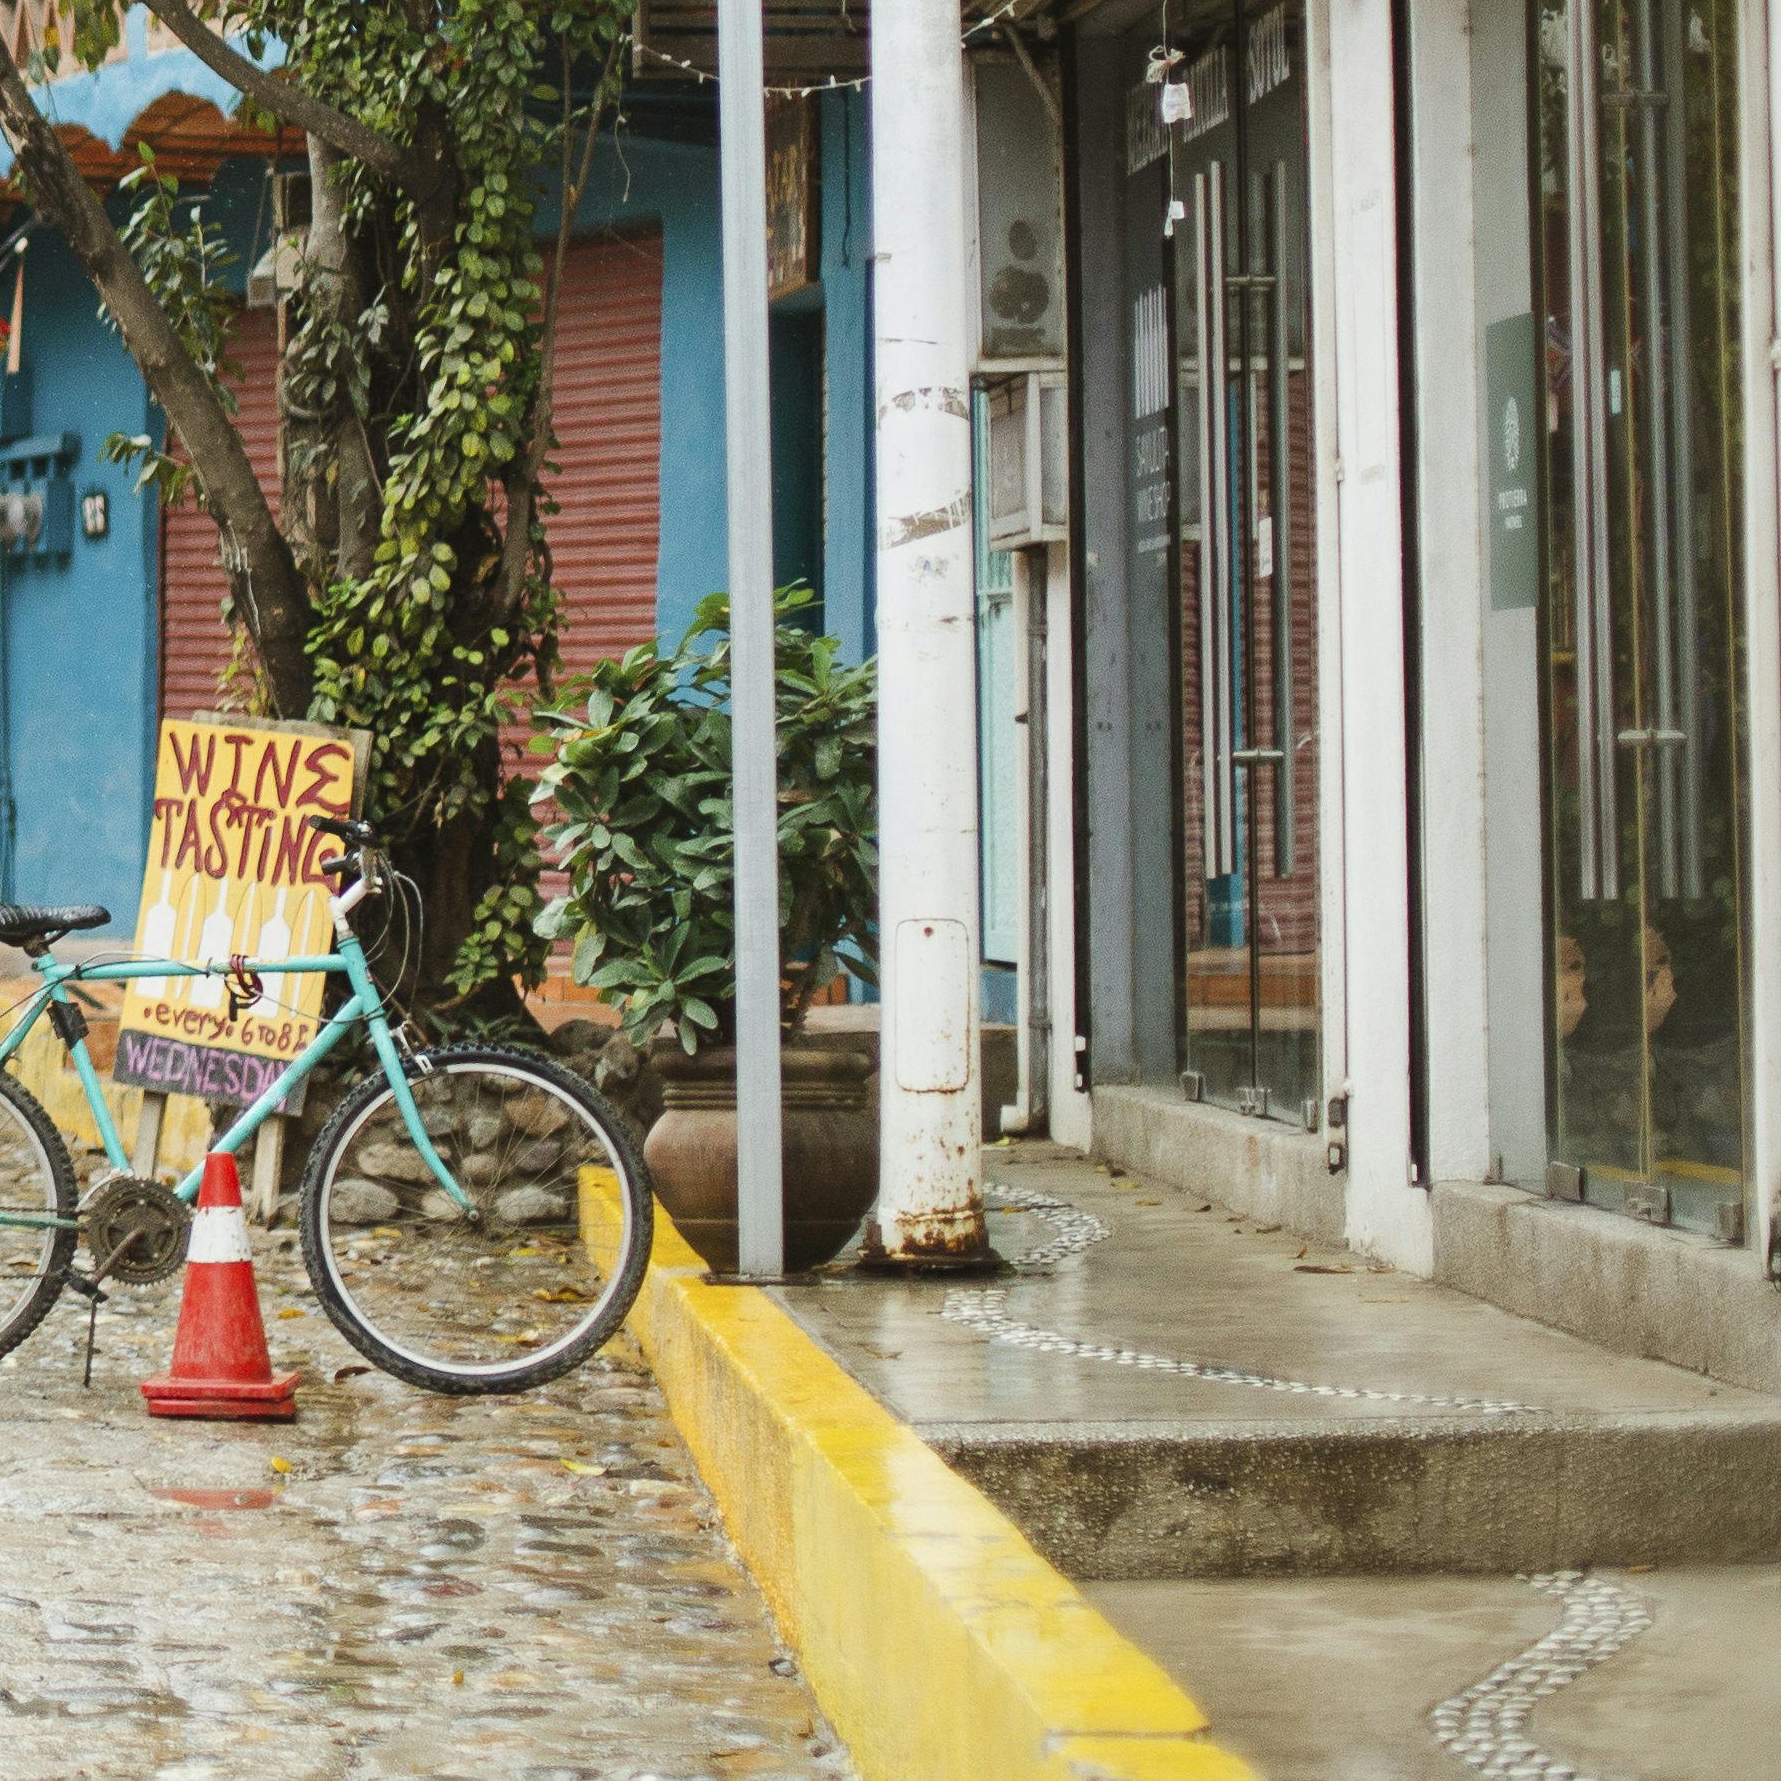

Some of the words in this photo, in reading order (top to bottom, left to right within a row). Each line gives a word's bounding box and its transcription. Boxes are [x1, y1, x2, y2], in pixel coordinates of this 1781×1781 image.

[1249, 2, 1290, 106] SOTOL
[169, 731, 352, 814] WINE
[154, 785, 343, 897] TASTING
